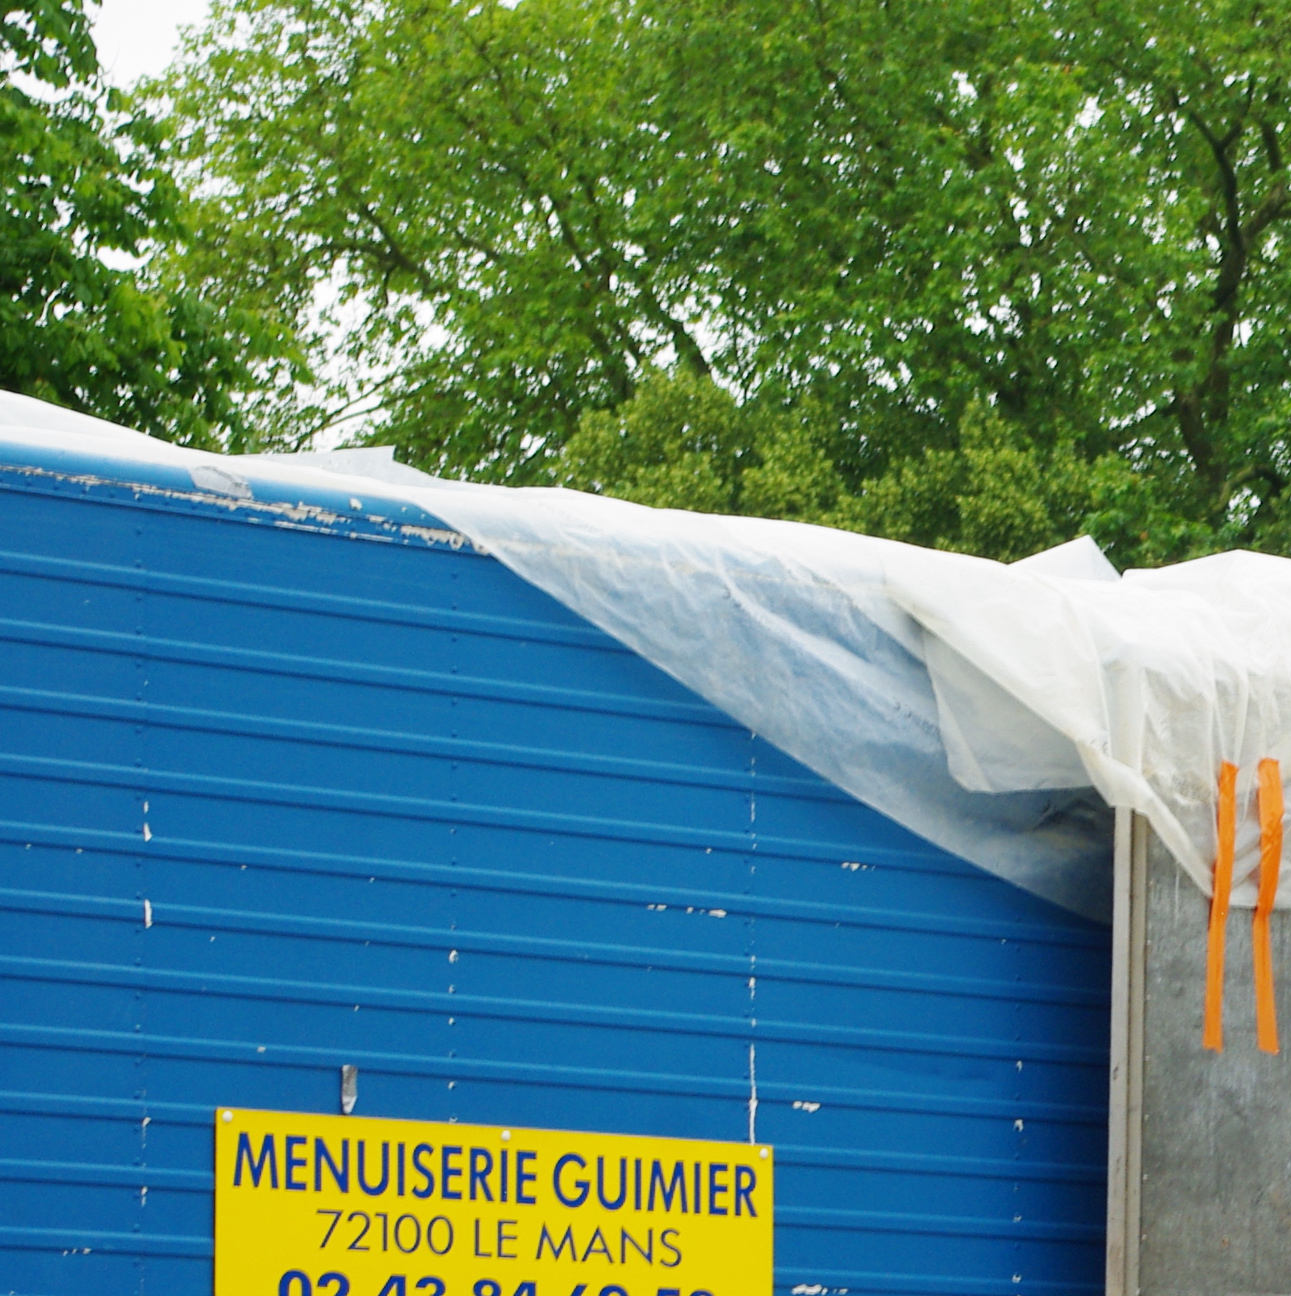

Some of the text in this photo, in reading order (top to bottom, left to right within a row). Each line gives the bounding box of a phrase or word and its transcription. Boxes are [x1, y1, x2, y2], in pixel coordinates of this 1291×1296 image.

[233, 1132, 758, 1217] MENUISERIE GUIMIER
[316, 1209, 682, 1267] 72100 LE MANS
